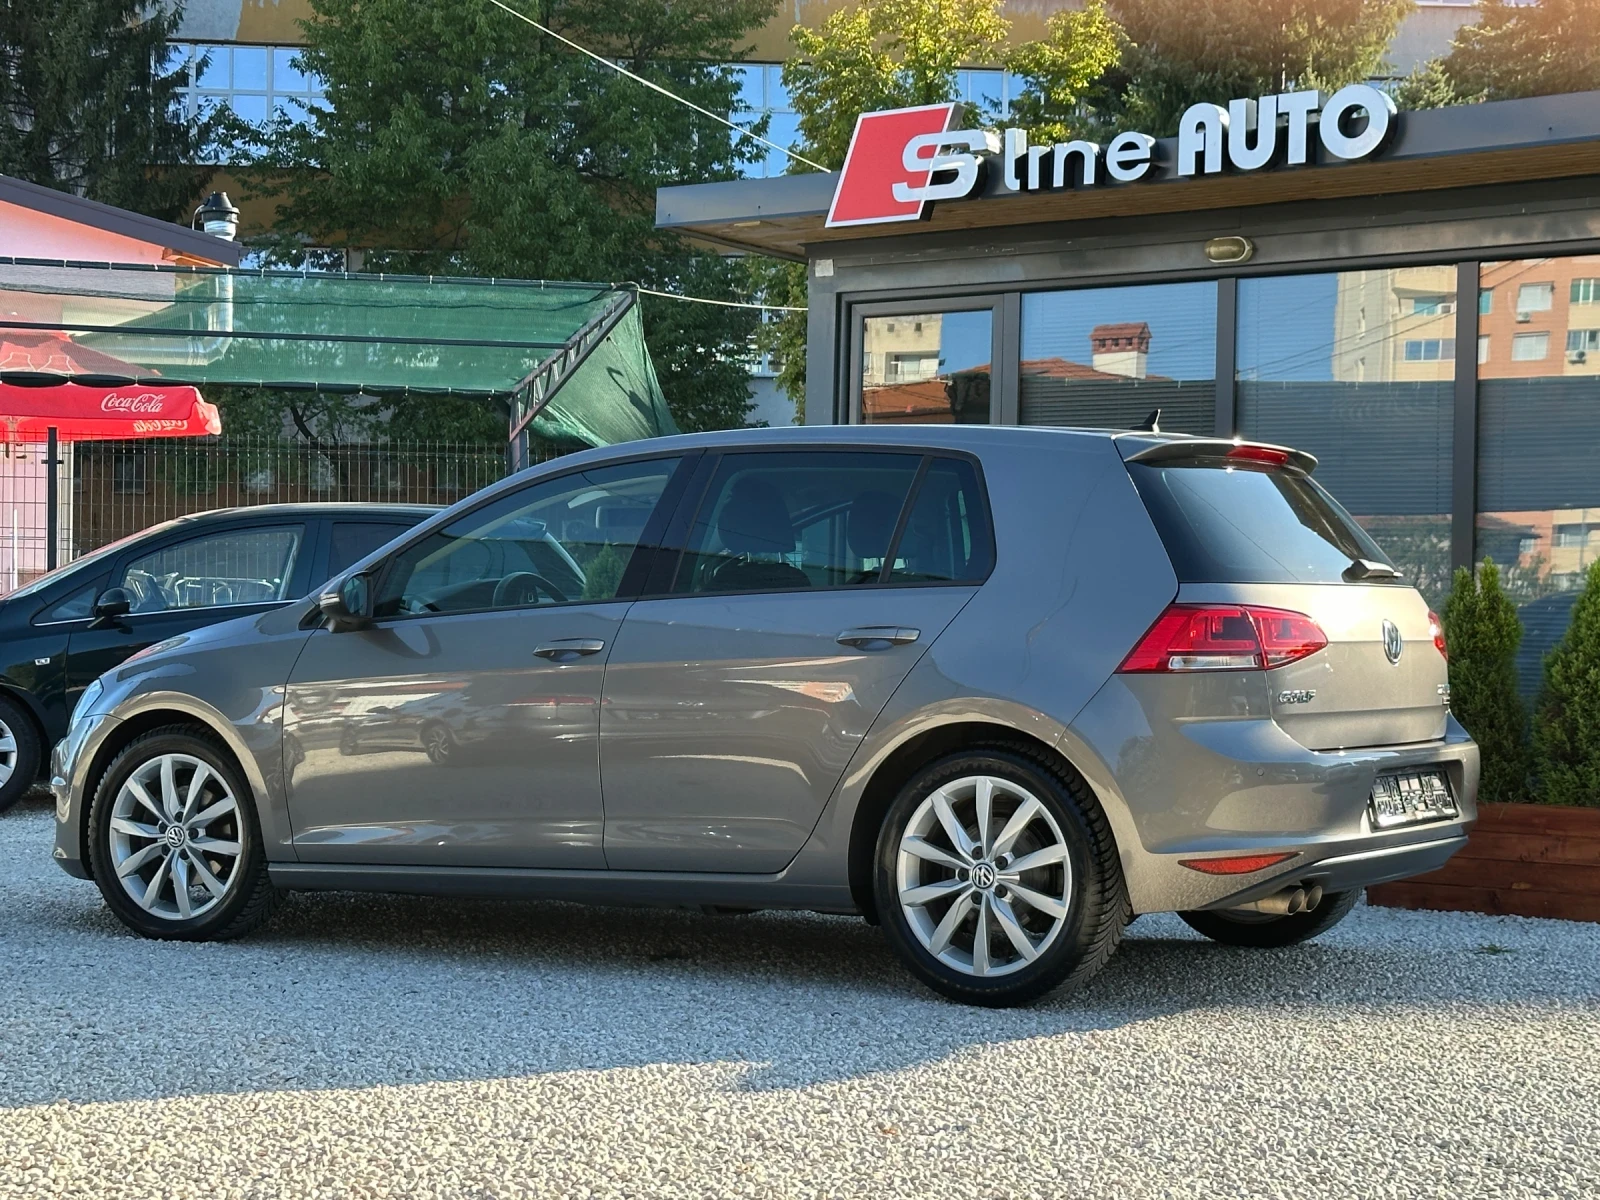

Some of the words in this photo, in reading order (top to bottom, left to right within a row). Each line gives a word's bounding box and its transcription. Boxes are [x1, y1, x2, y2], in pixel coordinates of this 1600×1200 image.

[892, 129, 990, 202] S
[1004, 128, 1153, 191] line
[1177, 84, 1391, 176] AUTO
[1278, 689, 1316, 703] GOLF
